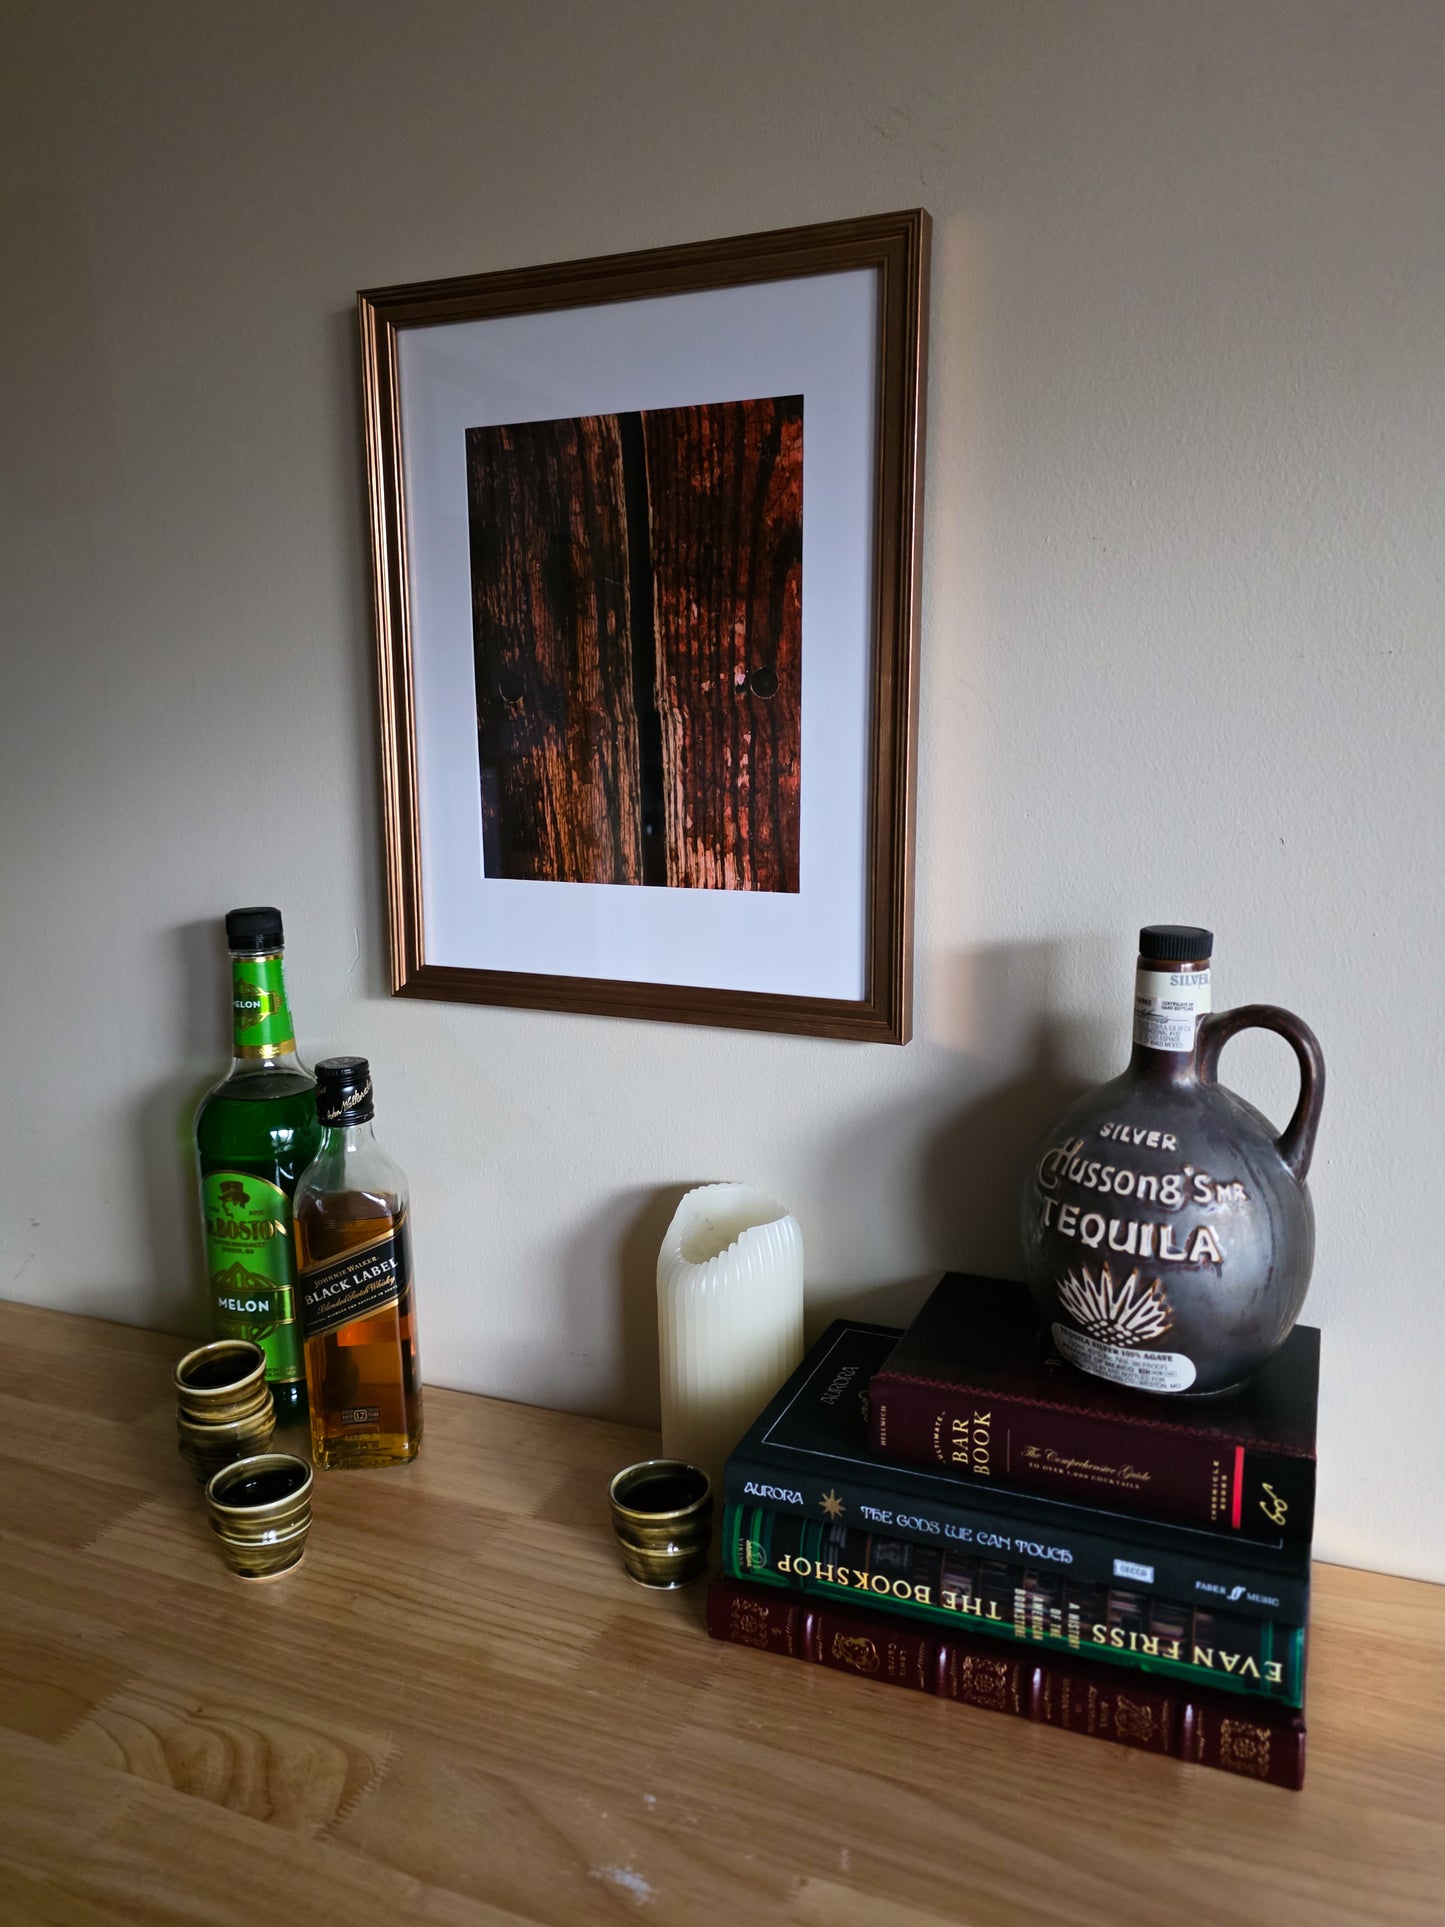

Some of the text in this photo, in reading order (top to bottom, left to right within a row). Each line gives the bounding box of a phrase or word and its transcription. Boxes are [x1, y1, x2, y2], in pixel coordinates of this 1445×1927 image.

[232, 1000, 260, 1008] ELON
[1099, 1122, 1178, 1151] SILVER
[216, 1218, 287, 1240] BOSTON
[1043, 1196, 1223, 1263] TEQUILA
[305, 1258, 399, 1305] BLACK LABEL
[314, 1270, 347, 1288] JOHNNIE
[367, 1275, 396, 1291] Whisky
[219, 1297, 269, 1312] MELON
[1060, 1326, 1090, 1346] TEQUILA
[1092, 1341, 1119, 1355] SILVER
[1144, 1353, 1173, 1362] AGAVE
[1105, 1360, 1134, 1372] MEXICO
[820, 1366, 860, 1405] AURORA
[356, 1411, 365, 1420] 12
[933, 1414, 944, 1460] ULTIMATE
[952, 1418, 969, 1464] BAR
[973, 1410, 991, 1476] BOOK
[1021, 1446, 1151, 1482] The Comprehensive Guide
[1042, 1465, 1064, 1475] OVER
[1091, 1474, 1140, 1490] COCKTAILS
[744, 1481, 1073, 1564] AURORA THE GODS WE CAN TOUCH
[777, 1555, 1002, 1621] THE BOOKSHOP
[1195, 1581, 1226, 1595] FABER
[1013, 1588, 1026, 1640] BOOKSTORE
[1031, 1596, 1043, 1641] AMERICAN
[1050, 1608, 1062, 1639] OF THE
[1068, 1611, 1080, 1650] HISTORY
[1091, 1624, 1283, 1683] EVAN FRISS
